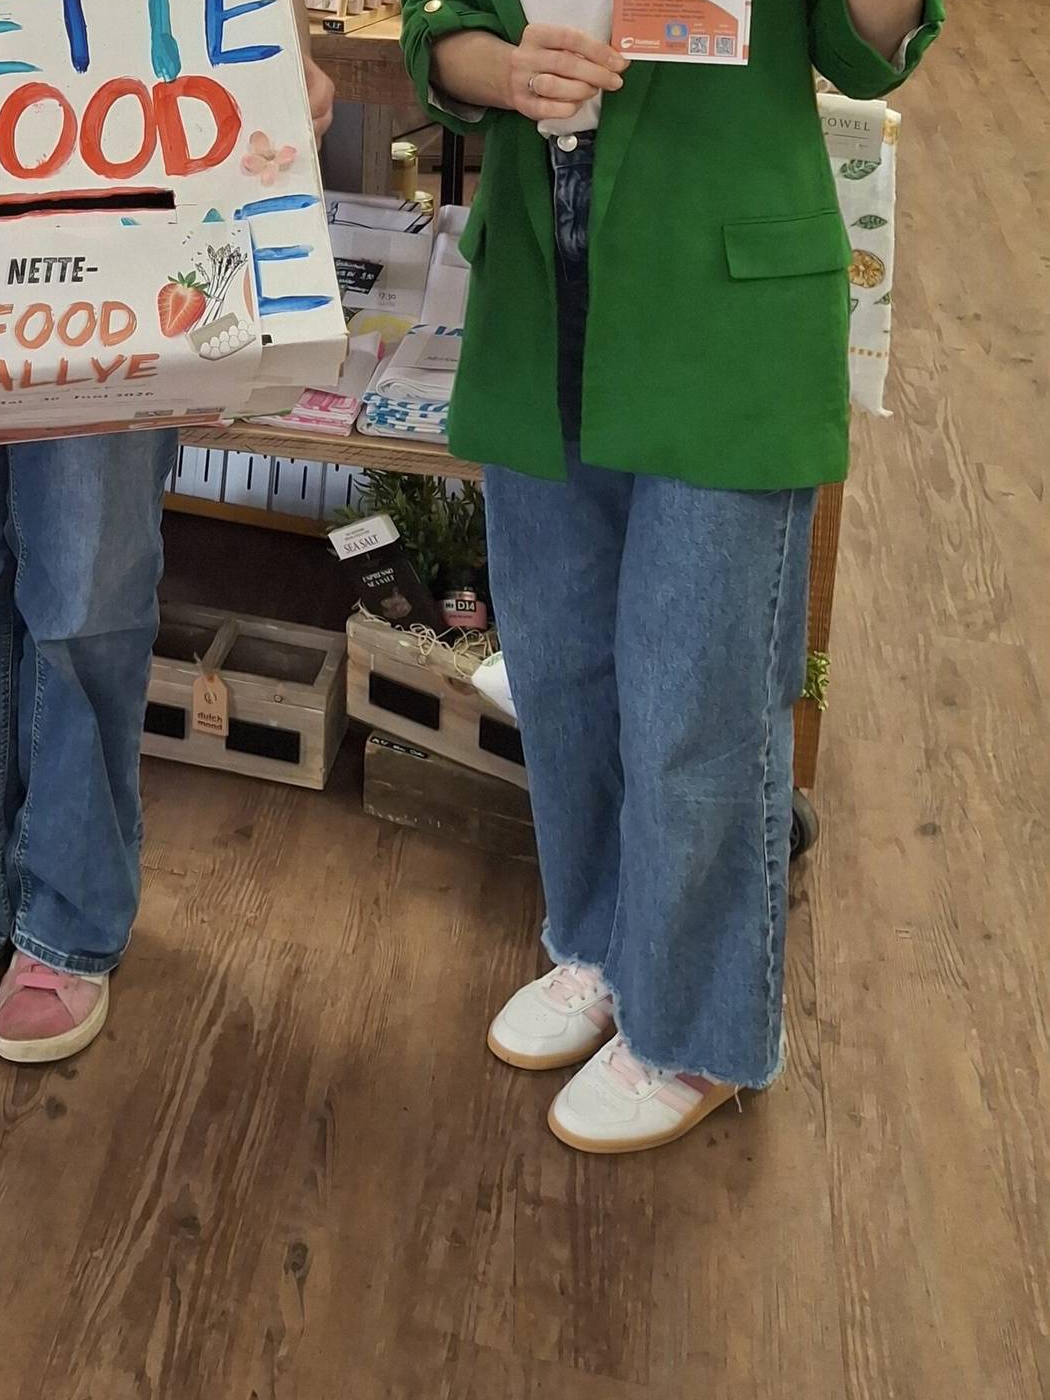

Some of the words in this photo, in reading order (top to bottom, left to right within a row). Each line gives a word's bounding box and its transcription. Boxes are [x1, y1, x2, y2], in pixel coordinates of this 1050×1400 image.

[7, 255, 98, 287] NETTE-
[343, 542, 362, 554] SEA
[361, 534, 380, 548] SALT
[457, 601, 475, 611] D14
[197, 711, 223, 723] dutch
